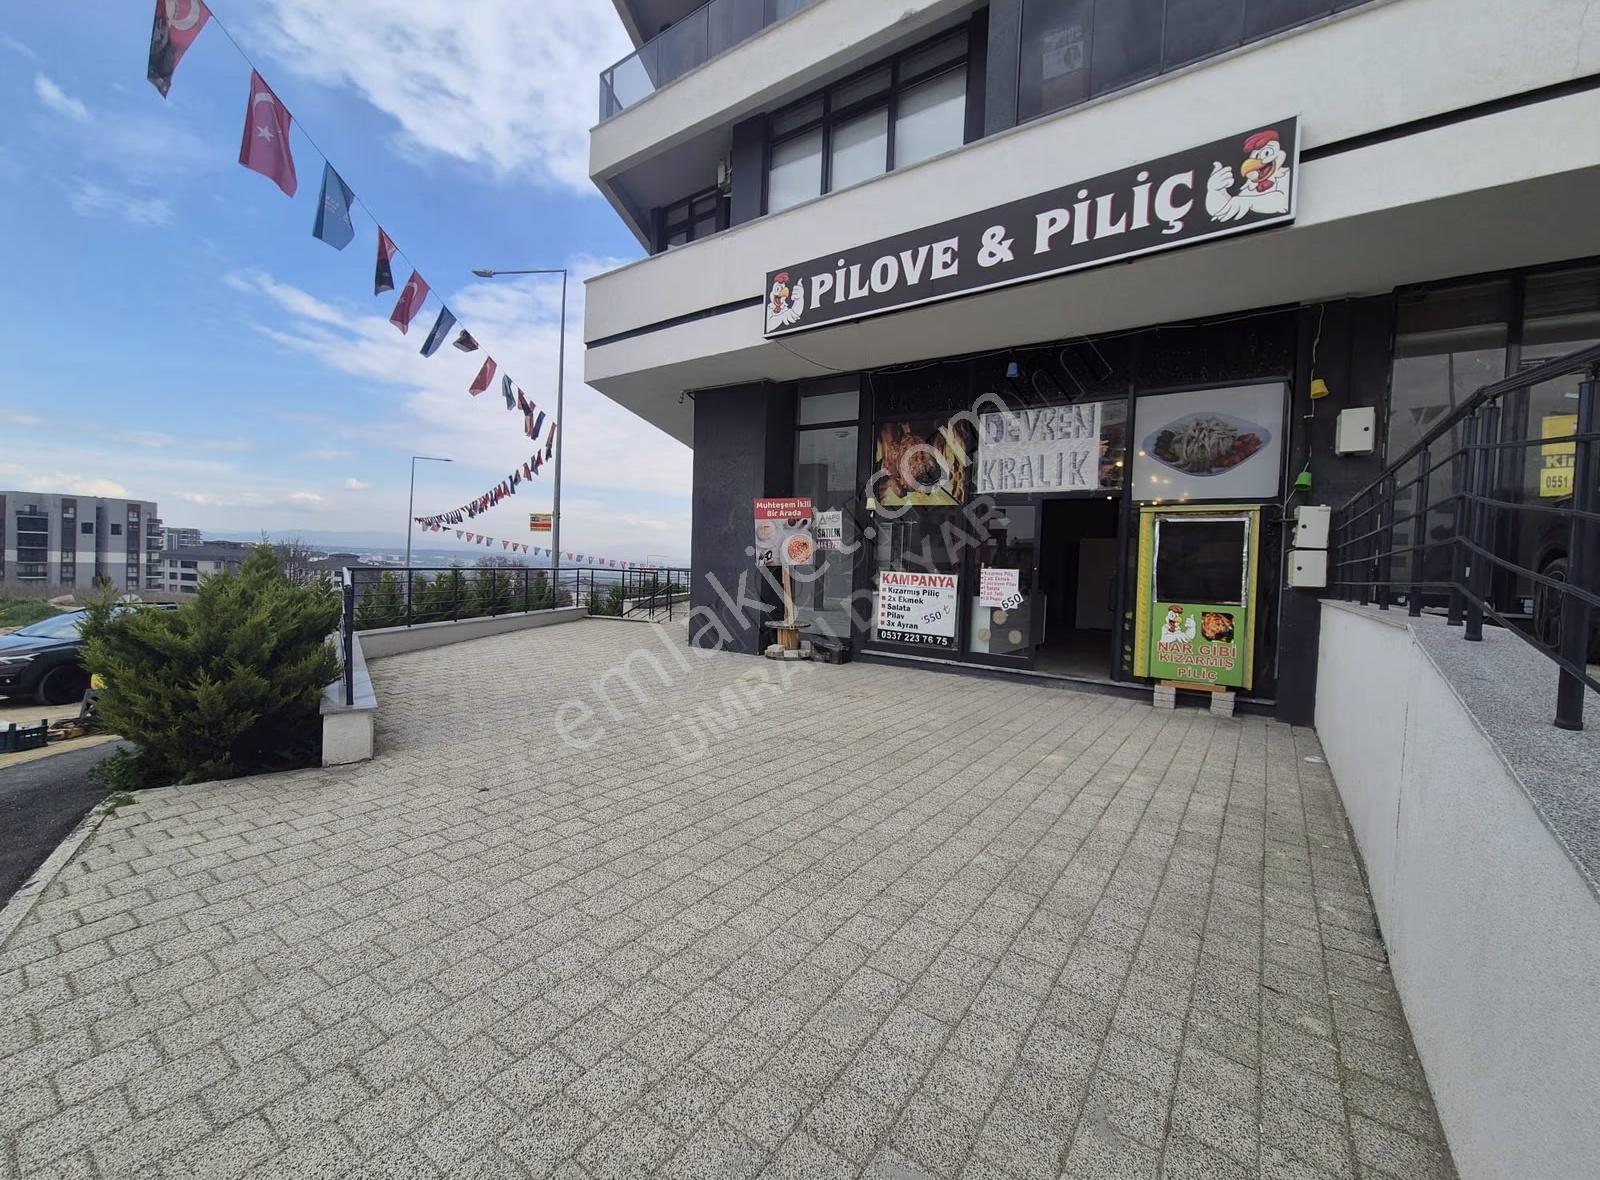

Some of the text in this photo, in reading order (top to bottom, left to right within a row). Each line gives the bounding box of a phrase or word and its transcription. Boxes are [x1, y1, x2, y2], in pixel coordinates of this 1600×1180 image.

[809, 170, 1196, 310] PİLOVE & PİLİÇ
[882, 573, 954, 588] KAMPANYA
[888, 587, 920, 596] Kızarmış
[922, 589, 940, 597] Piliç
[887, 603, 911, 611] Salata
[898, 596, 924, 604] Ekmek
[1001, 593, 1021, 609] 650
[886, 619, 919, 630] 3x Ayran
[881, 630, 948, 646] 0537 223 76 75
[1158, 641, 1237, 658] NAR GİBİ
[1177, 667, 1218, 682] PİLİÇ
